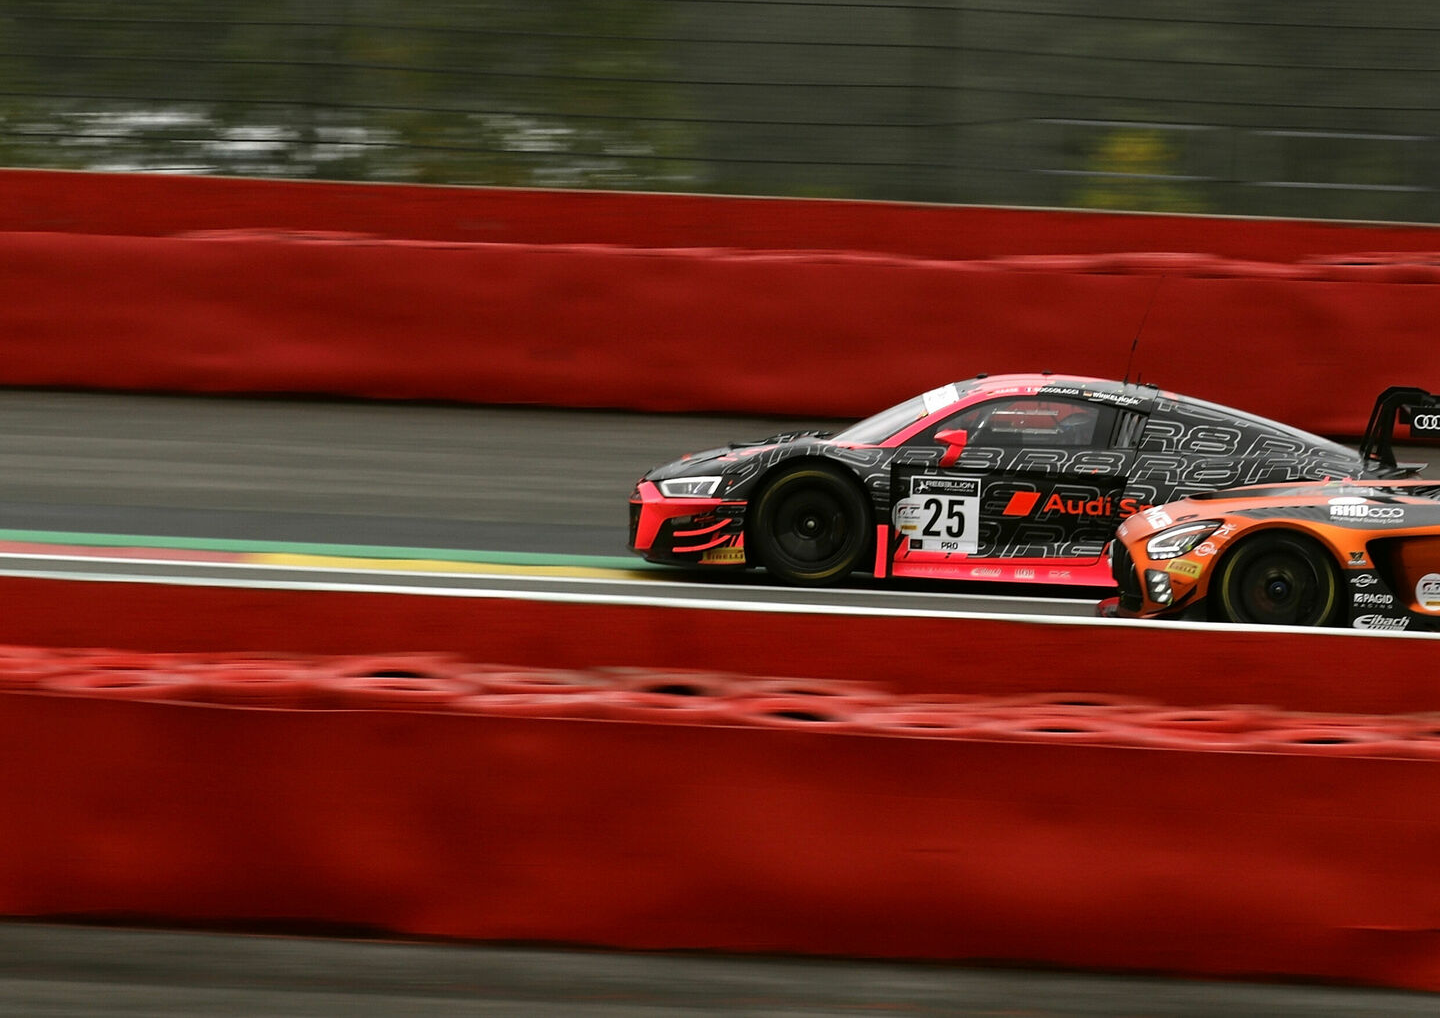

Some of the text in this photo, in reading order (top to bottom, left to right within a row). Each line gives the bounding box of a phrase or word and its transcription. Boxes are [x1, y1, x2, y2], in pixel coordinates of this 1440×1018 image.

[1043, 493, 1112, 517] Audi
[922, 497, 966, 538] 25
[941, 542, 959, 550] PRO
[1363, 593, 1393, 605] PAGID
[1353, 613, 1411, 630] Eibach
